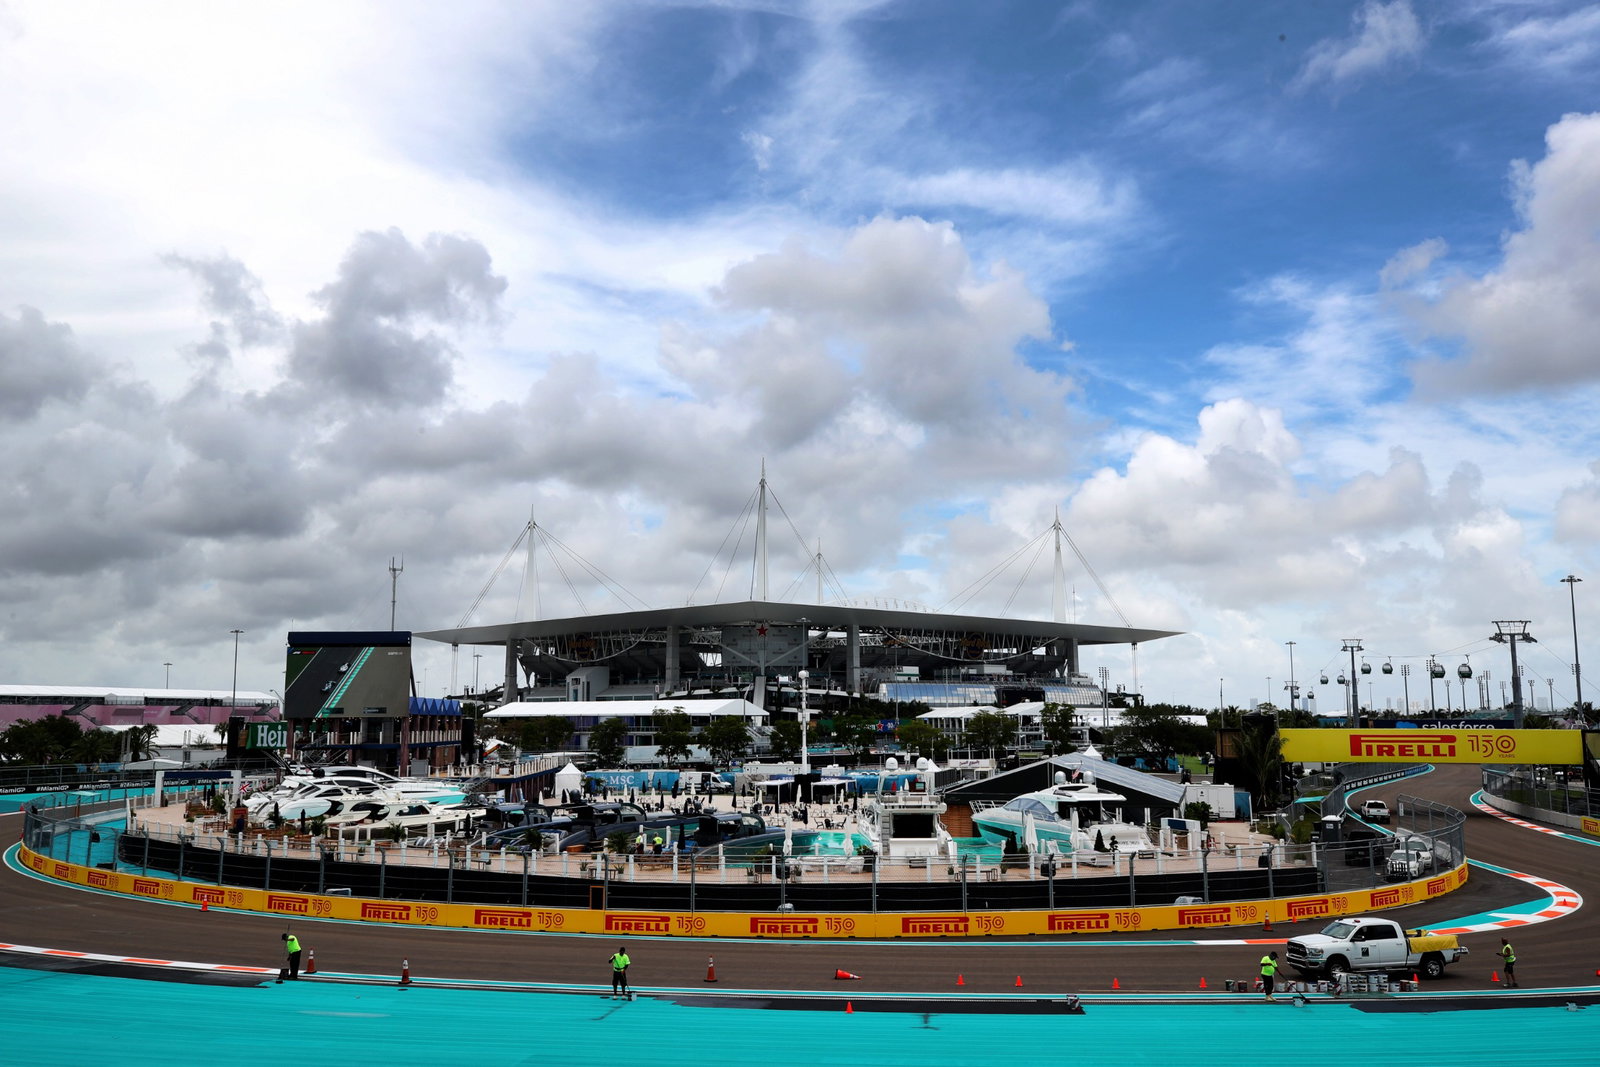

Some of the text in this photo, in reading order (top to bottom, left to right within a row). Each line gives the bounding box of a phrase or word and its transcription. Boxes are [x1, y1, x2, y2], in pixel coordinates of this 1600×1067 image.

[1349, 734, 1516, 758] PIRELLI 150
[609, 775, 635, 785] MSC
[87, 871, 108, 887] PIRELLI
[133, 879, 160, 895] PIRELLI
[1427, 878, 1446, 896] PIRELLI
[192, 887, 244, 906] PIRELLI 150
[267, 895, 332, 915] PIRELLI 150
[1370, 888, 1400, 908] PIRELLI
[361, 902, 439, 922] PIRELLI 150
[1178, 905, 1257, 925] PIRELLI 150
[1287, 896, 1349, 917] PIRELLI 150
[474, 909, 564, 928] PIRELLI 150
[605, 914, 706, 933] PIRELLI 150
[750, 917, 855, 934] PIRELLI 150
[901, 916, 1005, 933] PIRELLI 150
[1048, 912, 1141, 931] PIRELLI 150
